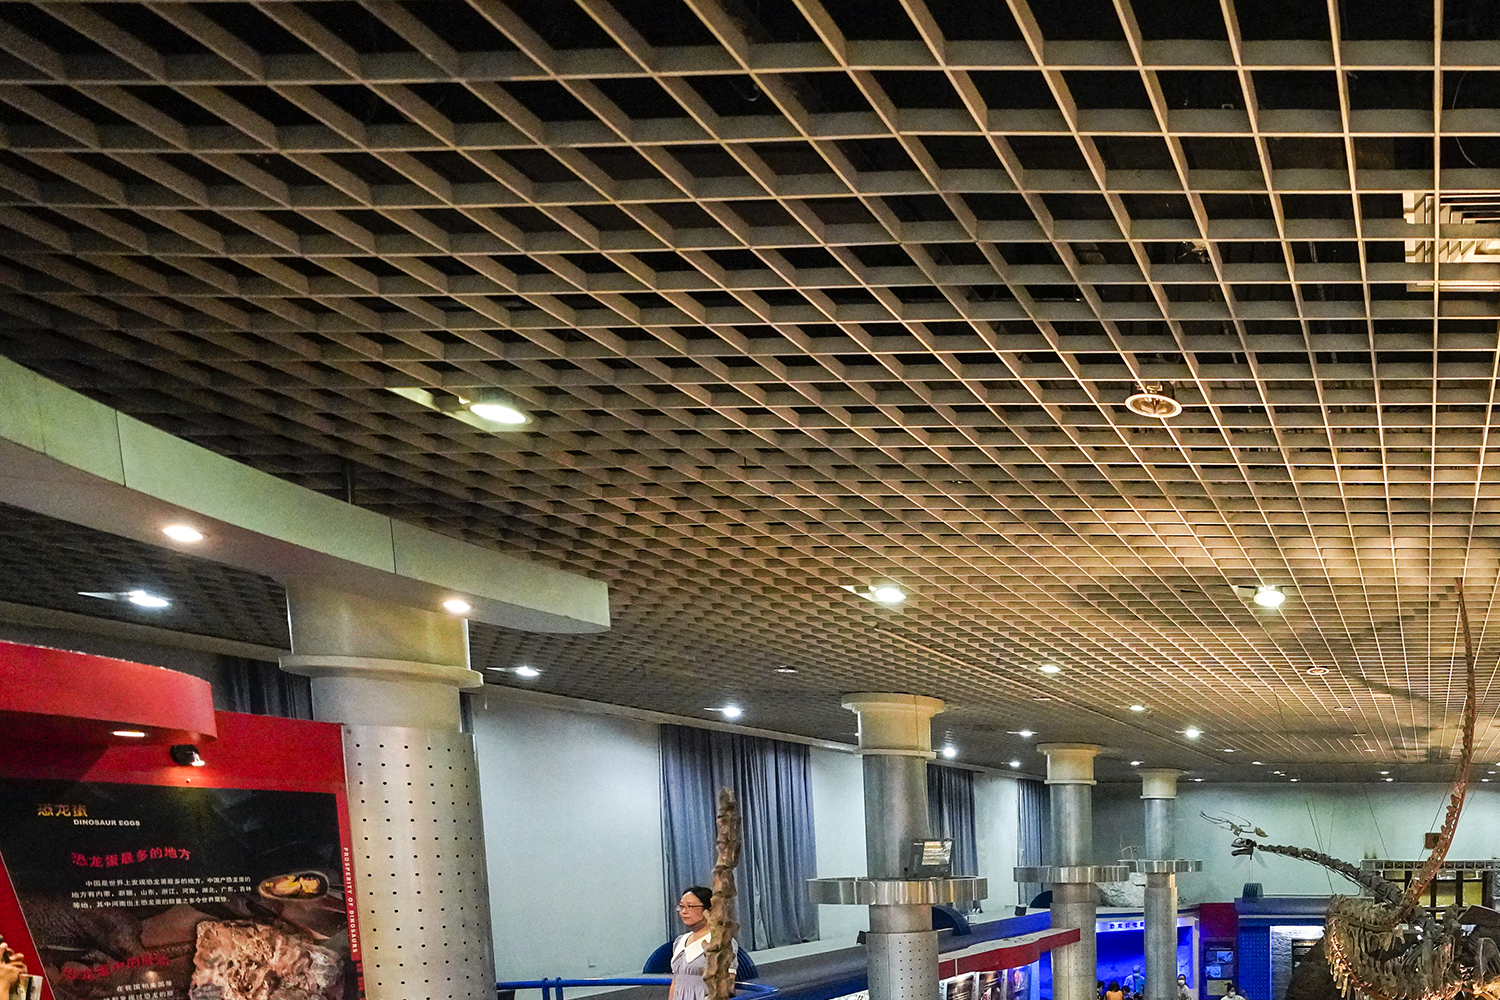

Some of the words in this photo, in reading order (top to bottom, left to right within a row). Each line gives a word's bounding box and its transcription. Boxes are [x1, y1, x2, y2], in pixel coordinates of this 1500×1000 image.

[37, 804, 88, 817] 恐龙蛋
[73, 819, 117, 827] DINOSAUR
[71, 846, 191, 868] 恐龙蛋最多的地方
[343, 847, 353, 894] PROSPERITY
[347, 897, 354, 906] OF
[349, 910, 358, 953] DINOSAURS
